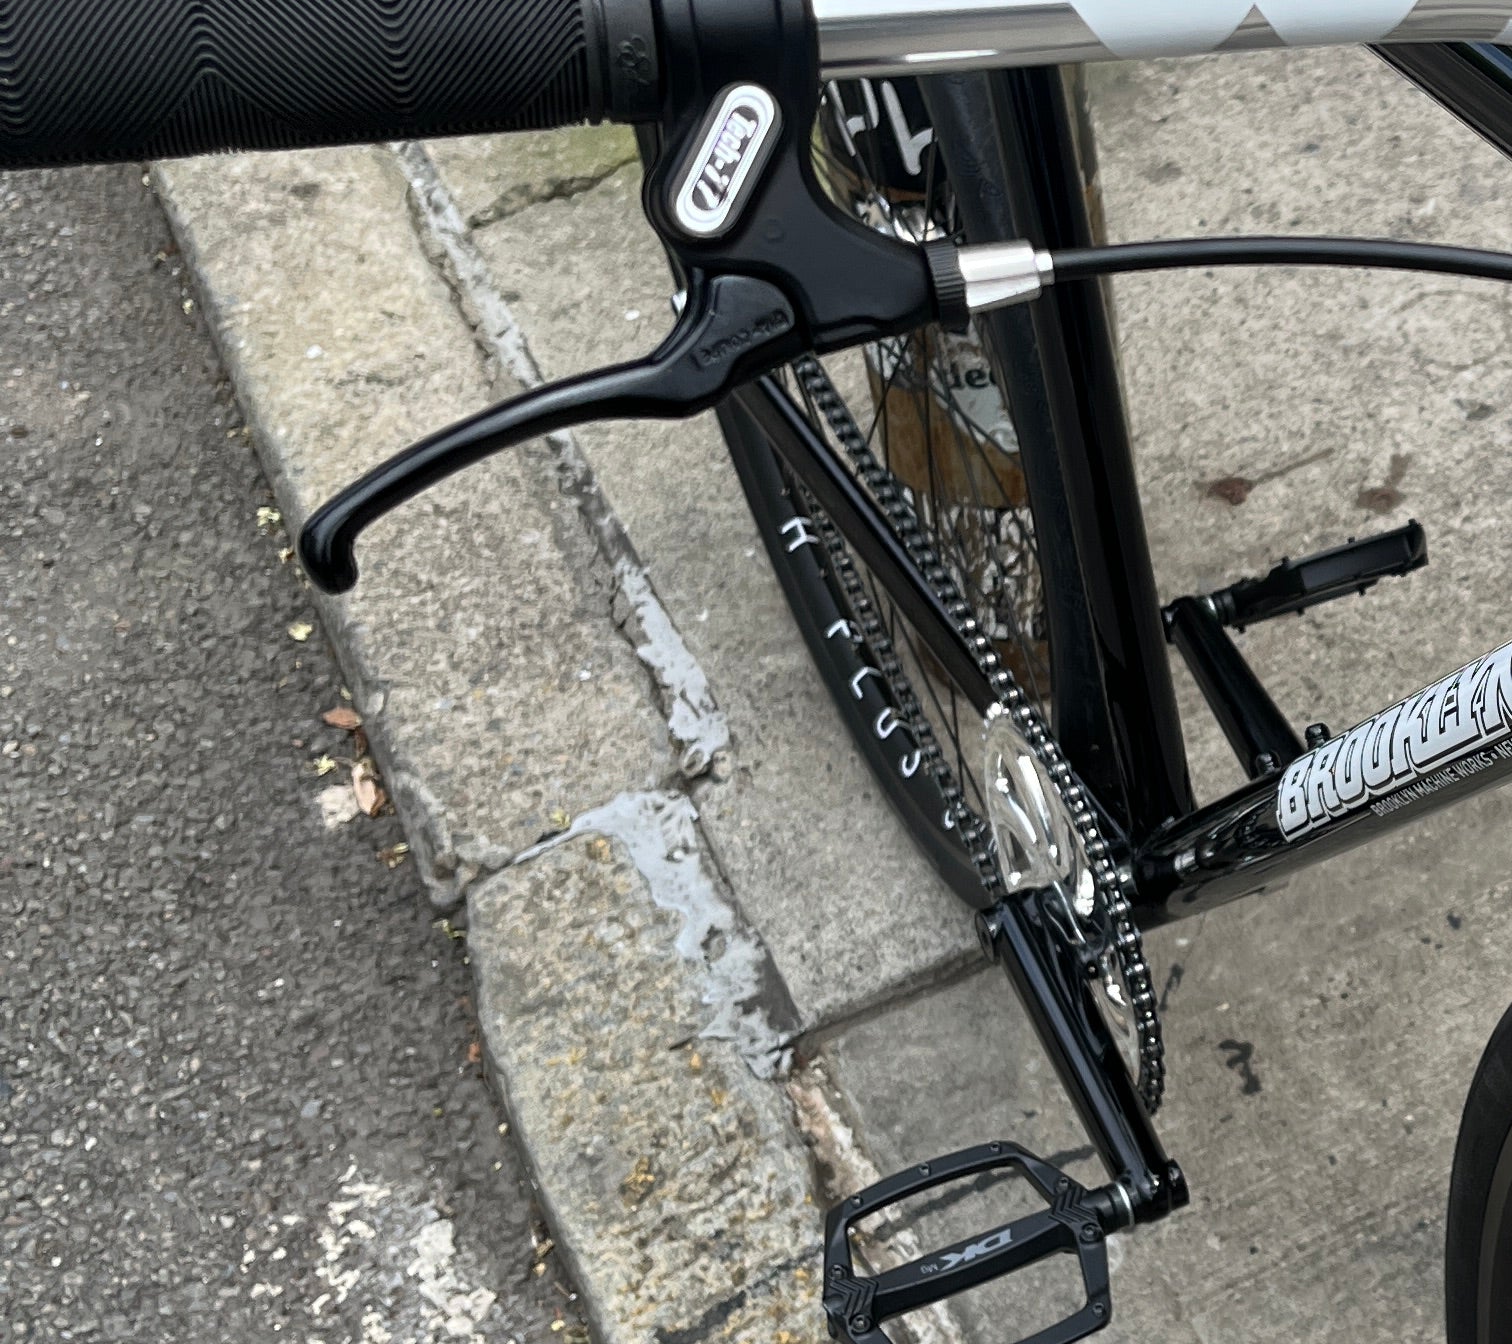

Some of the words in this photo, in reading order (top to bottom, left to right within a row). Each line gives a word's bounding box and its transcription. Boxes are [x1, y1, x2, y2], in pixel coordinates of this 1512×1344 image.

[1370, 785, 1420, 817] BROOKLYN
[1414, 766, 1460, 797] MACHINE
[1453, 750, 1494, 781] WORKS
